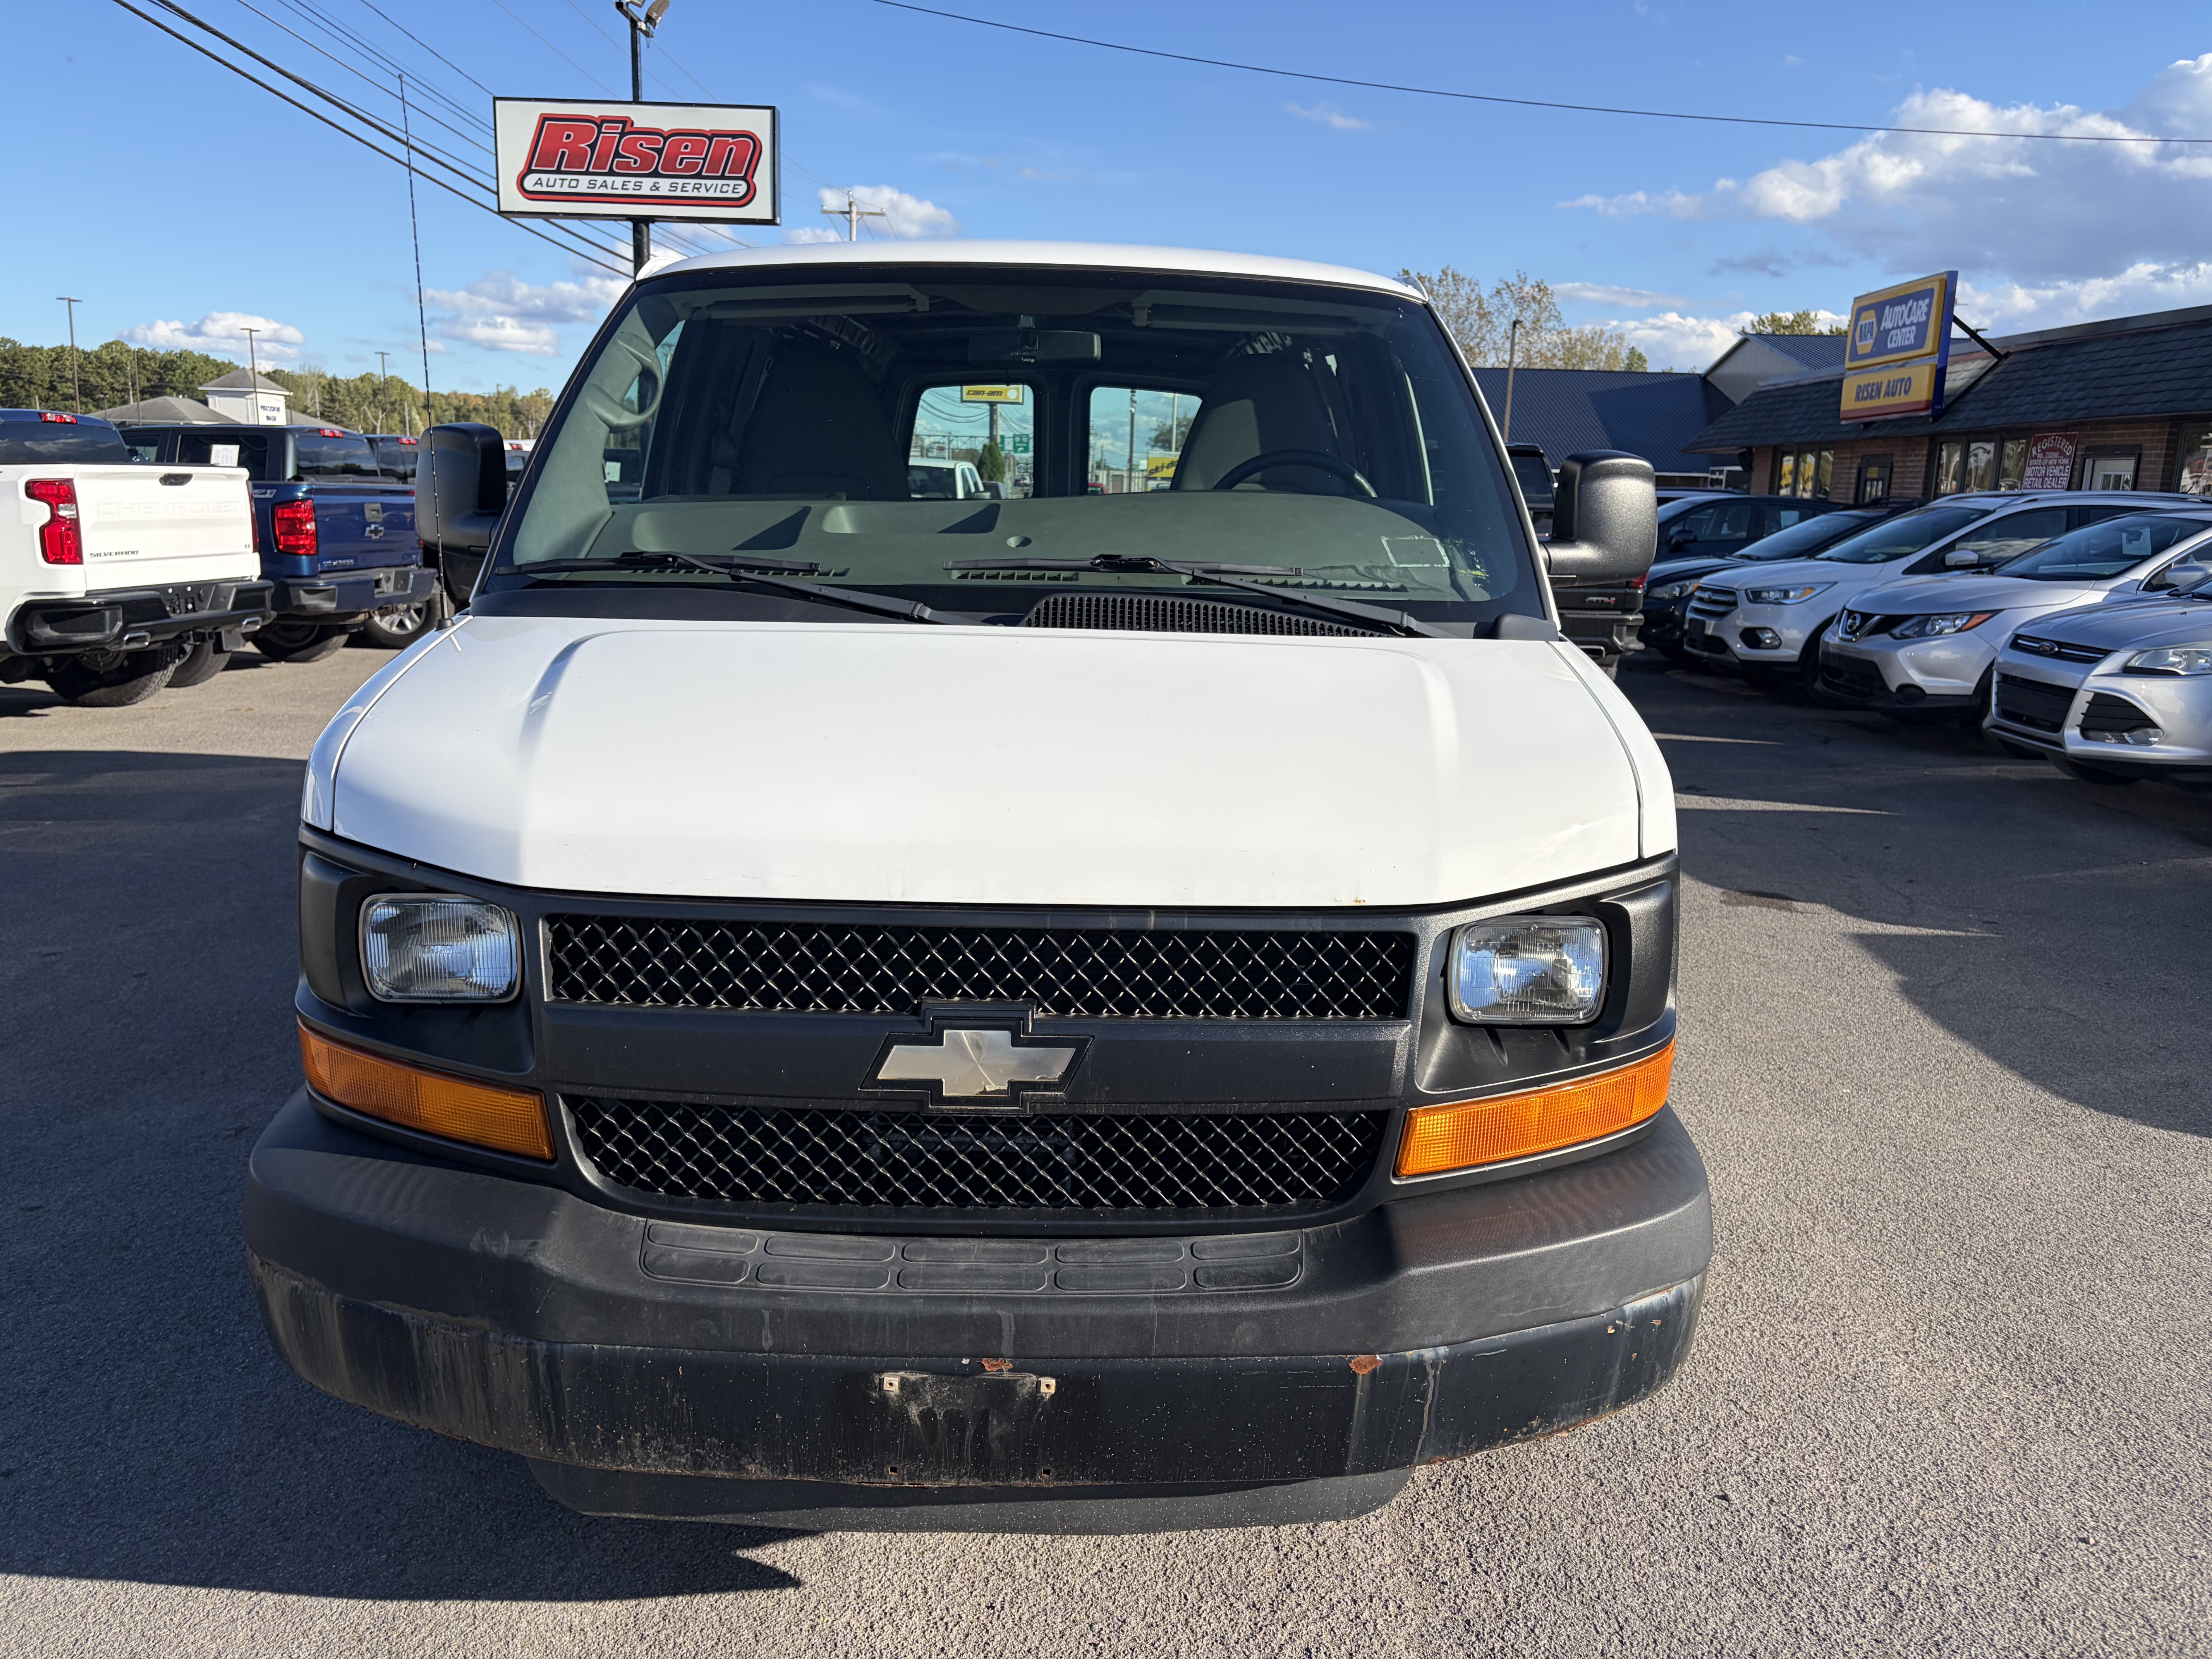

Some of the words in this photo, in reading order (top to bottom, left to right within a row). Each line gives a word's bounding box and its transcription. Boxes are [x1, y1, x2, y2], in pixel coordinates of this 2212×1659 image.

[531, 120, 754, 177] Risen
[532, 177, 579, 189] AUTO
[586, 179, 643, 191] SALES
[649, 181, 661, 192] &
[668, 182, 743, 194] SERVICE
[1859, 320, 1875, 343] NAPA
[1887, 325, 1916, 349] CENTER
[1855, 381, 1883, 402] RISEN
[1883, 376, 1912, 398] AUTO
[2032, 436, 2072, 457] REGISTERED
[2026, 466, 2046, 477] MOTOR
[2046, 465, 2069, 476] VEHICLE
[2023, 477, 2042, 488] RETAIL
[2043, 477, 2067, 488] DEALER
[89, 550, 139, 558] SILVERADO
